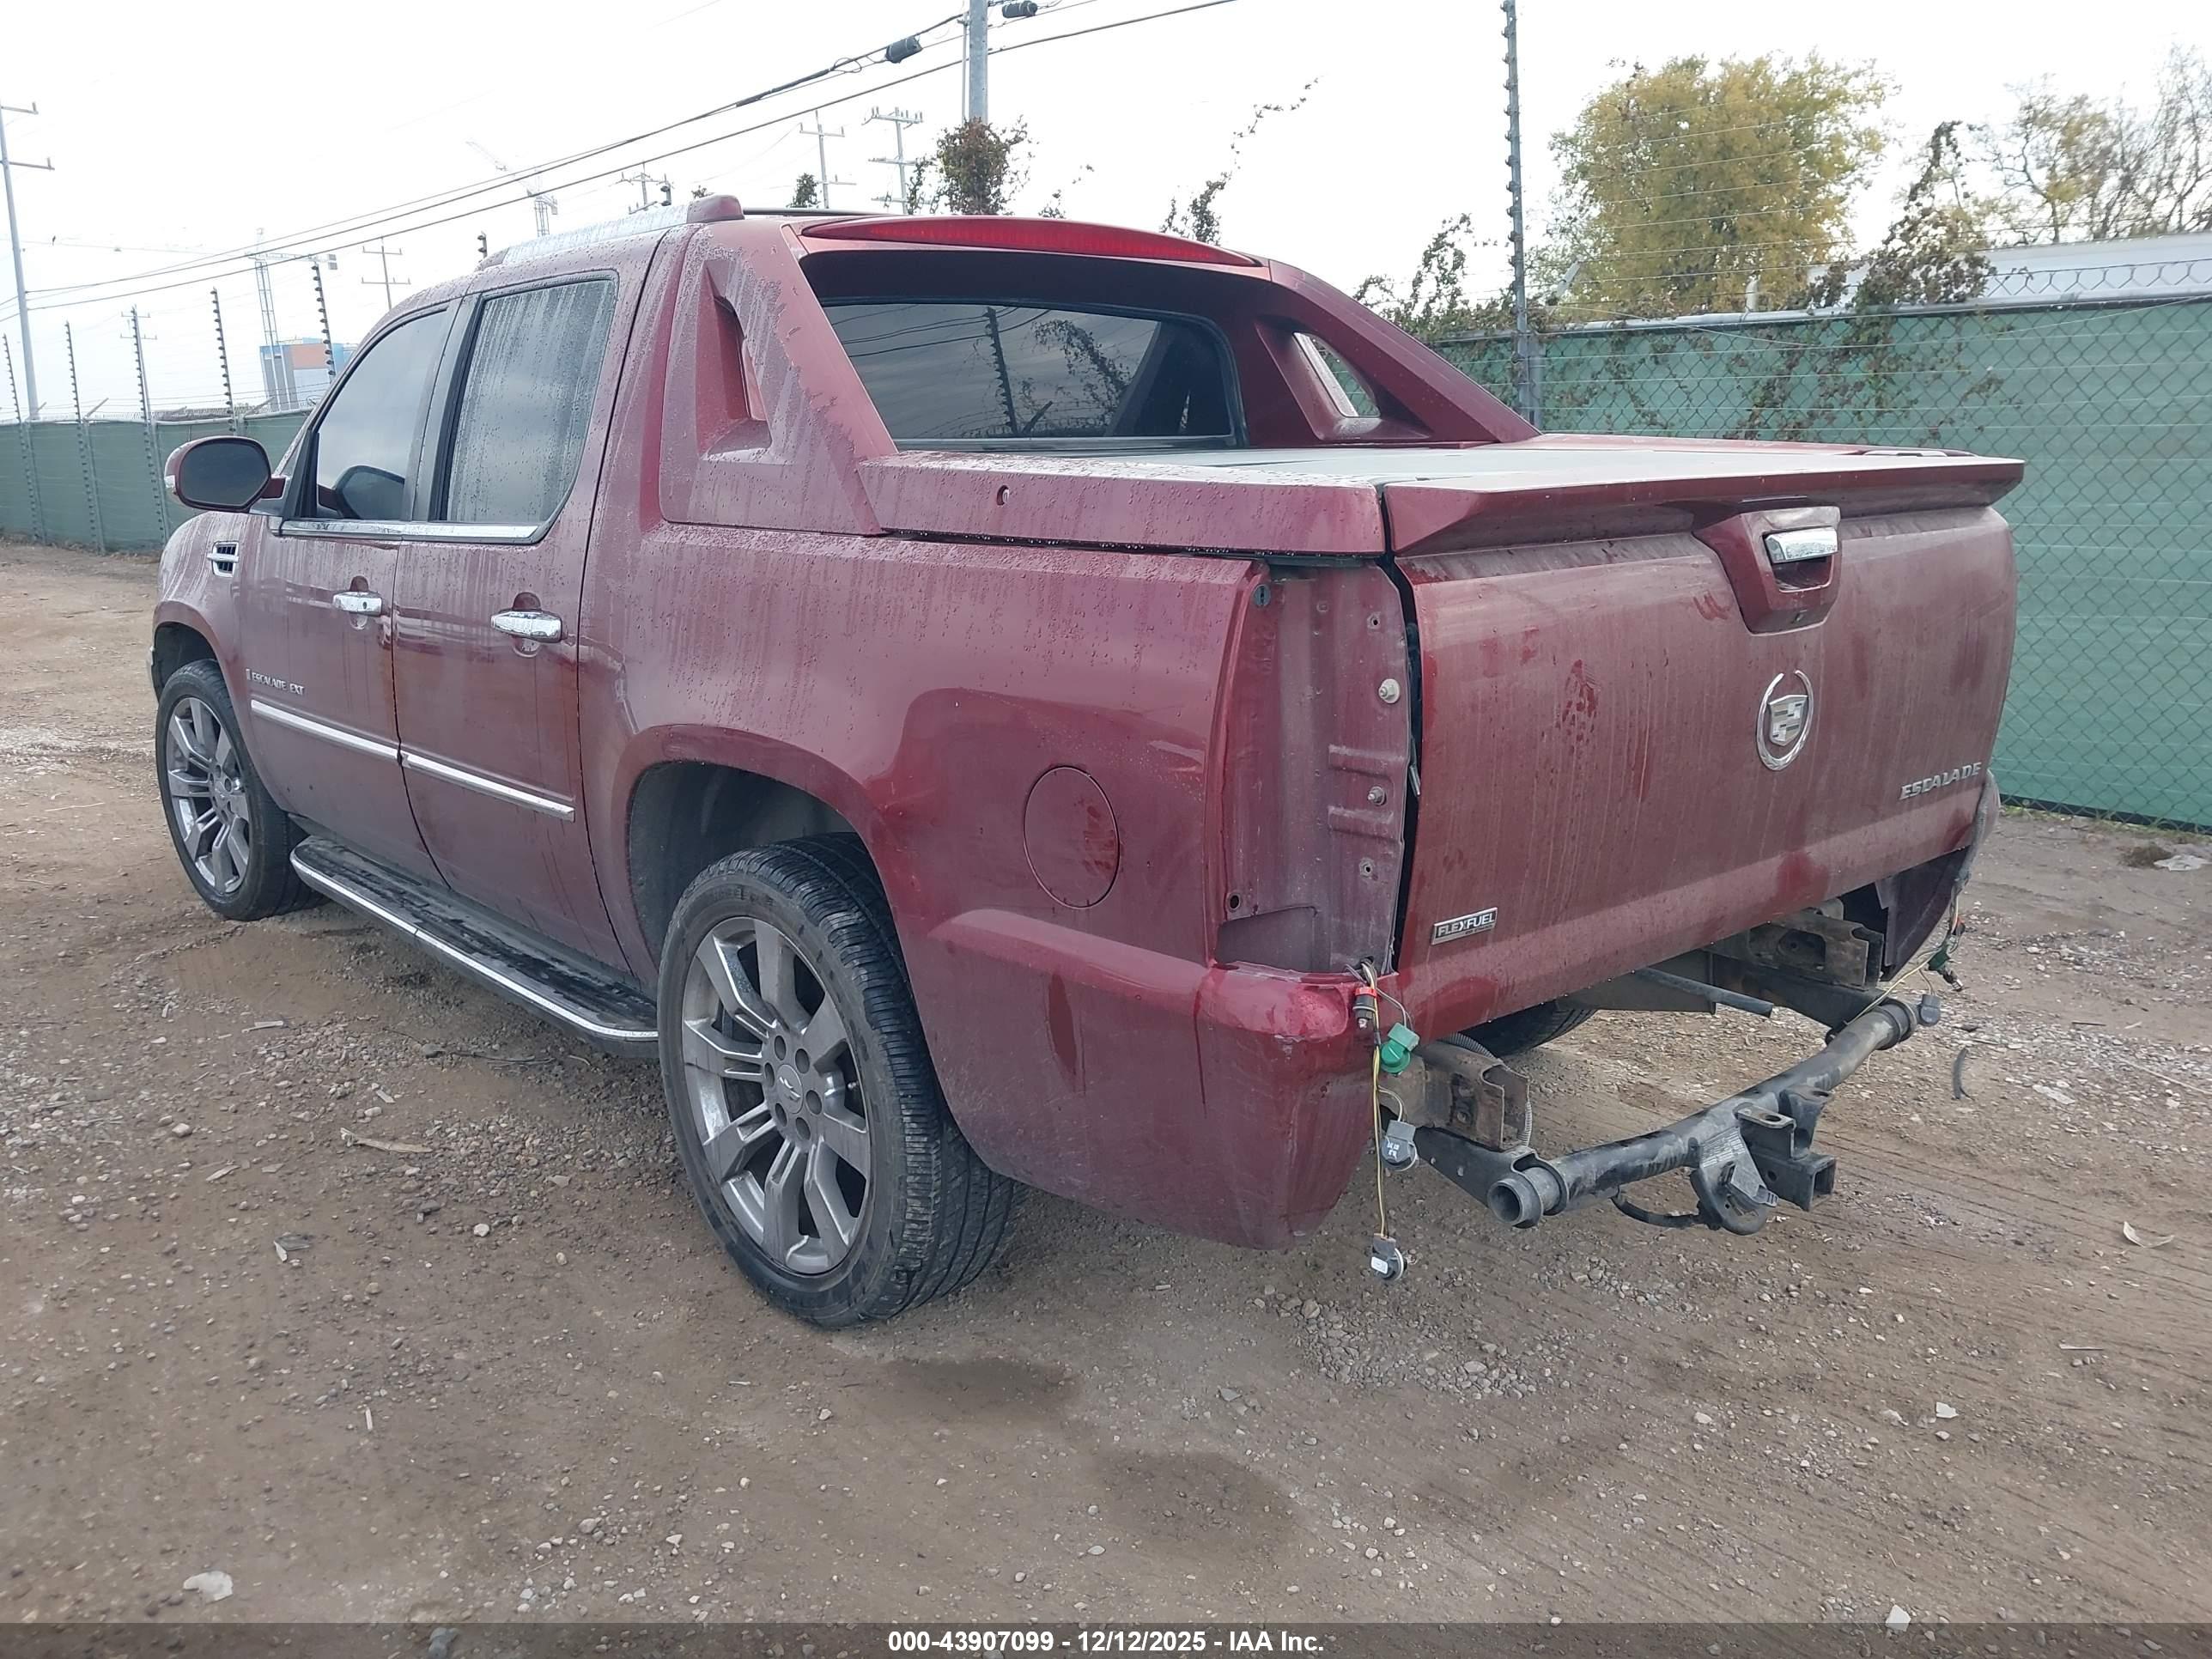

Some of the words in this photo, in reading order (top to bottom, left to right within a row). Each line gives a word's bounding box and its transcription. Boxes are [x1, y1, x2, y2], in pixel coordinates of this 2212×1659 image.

[252, 672, 287, 690] ESCALADE
[289, 684, 305, 696] EXT
[1899, 762, 1982, 800] ESCALADE
[1437, 912, 1495, 937] FLEXFUEL
